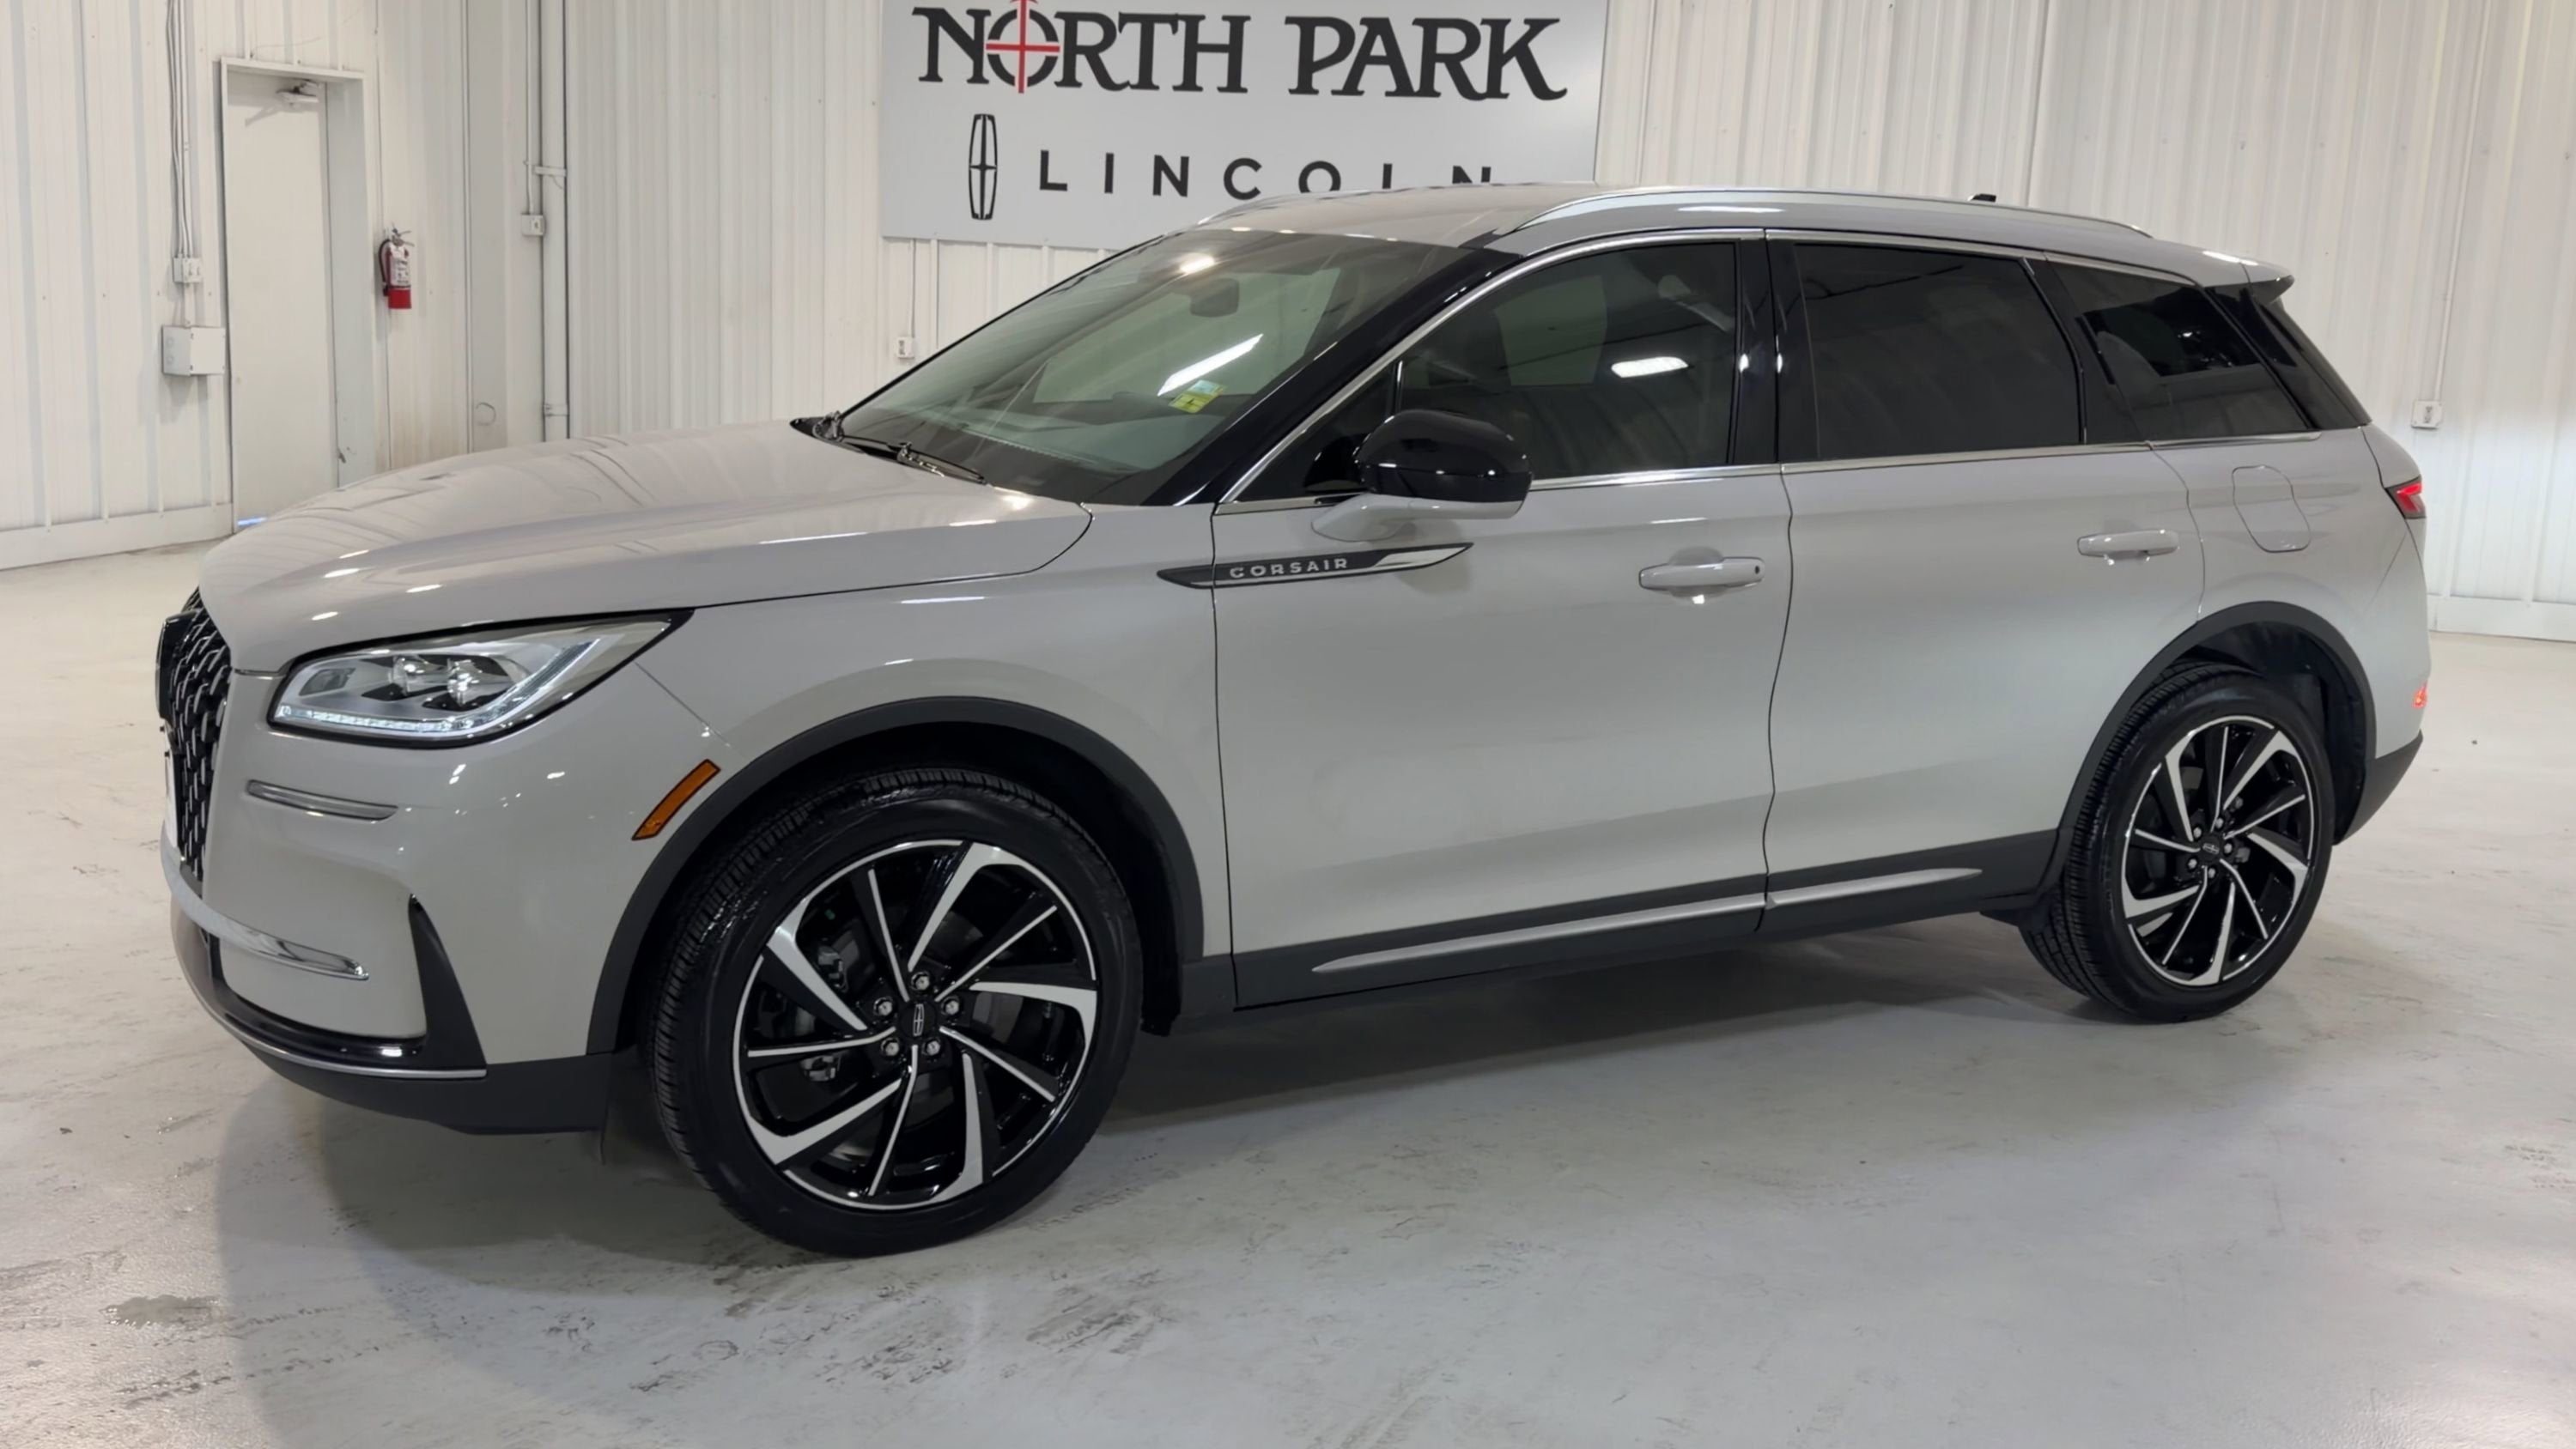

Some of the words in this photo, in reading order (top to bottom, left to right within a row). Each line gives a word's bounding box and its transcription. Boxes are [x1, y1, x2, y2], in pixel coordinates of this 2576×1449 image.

[912, 2, 1251, 94] NORTH
[1285, 15, 1568, 101] PARK
[1229, 557, 1348, 579] CORSAIR
